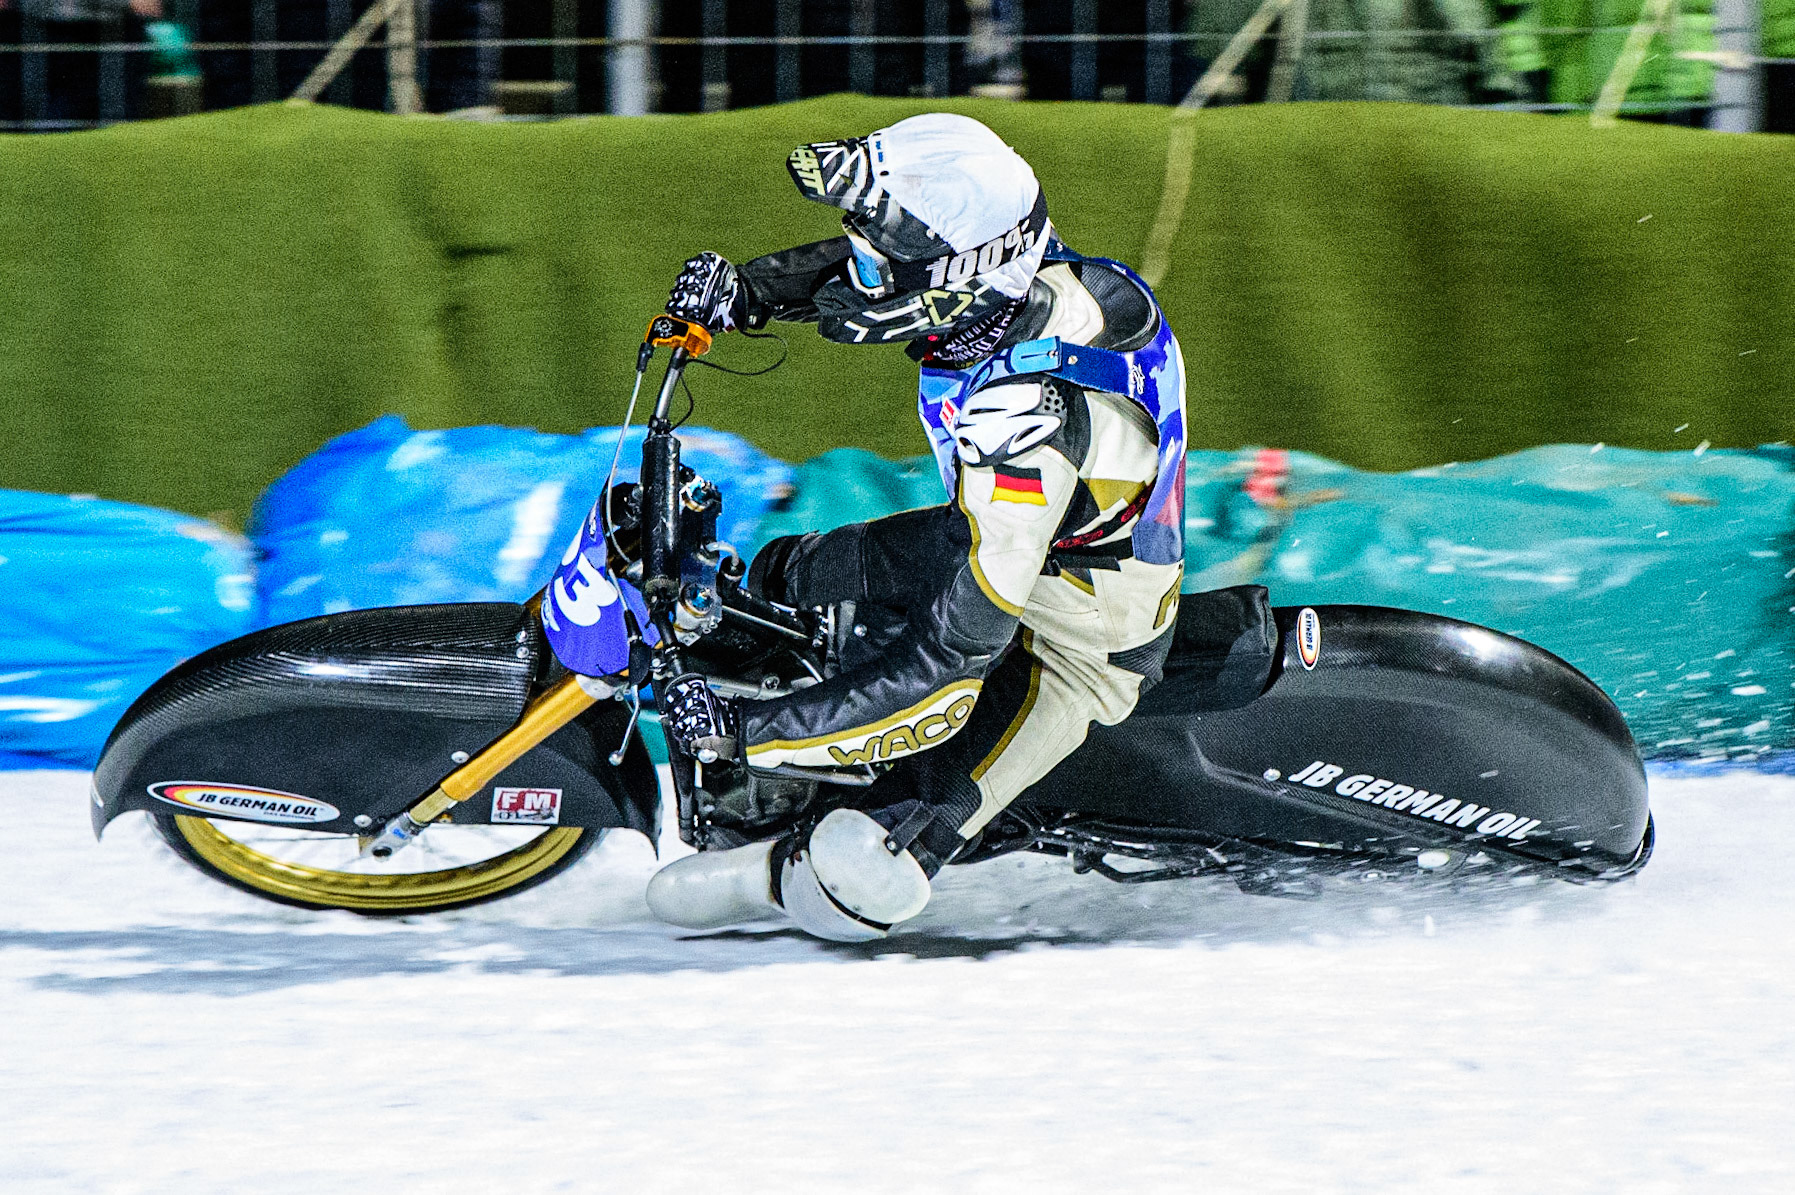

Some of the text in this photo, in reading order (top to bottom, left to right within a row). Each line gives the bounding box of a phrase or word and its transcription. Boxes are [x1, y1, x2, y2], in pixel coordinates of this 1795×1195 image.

[925, 219, 1035, 288] 100%
[828, 695, 975, 766] WACO
[197, 794, 217, 803] JB
[220, 797, 291, 813] GERMAN
[293, 805, 317, 816] OIL
[501, 792, 552, 810] FM
[1288, 761, 1542, 840] JB GERMAN OIL
